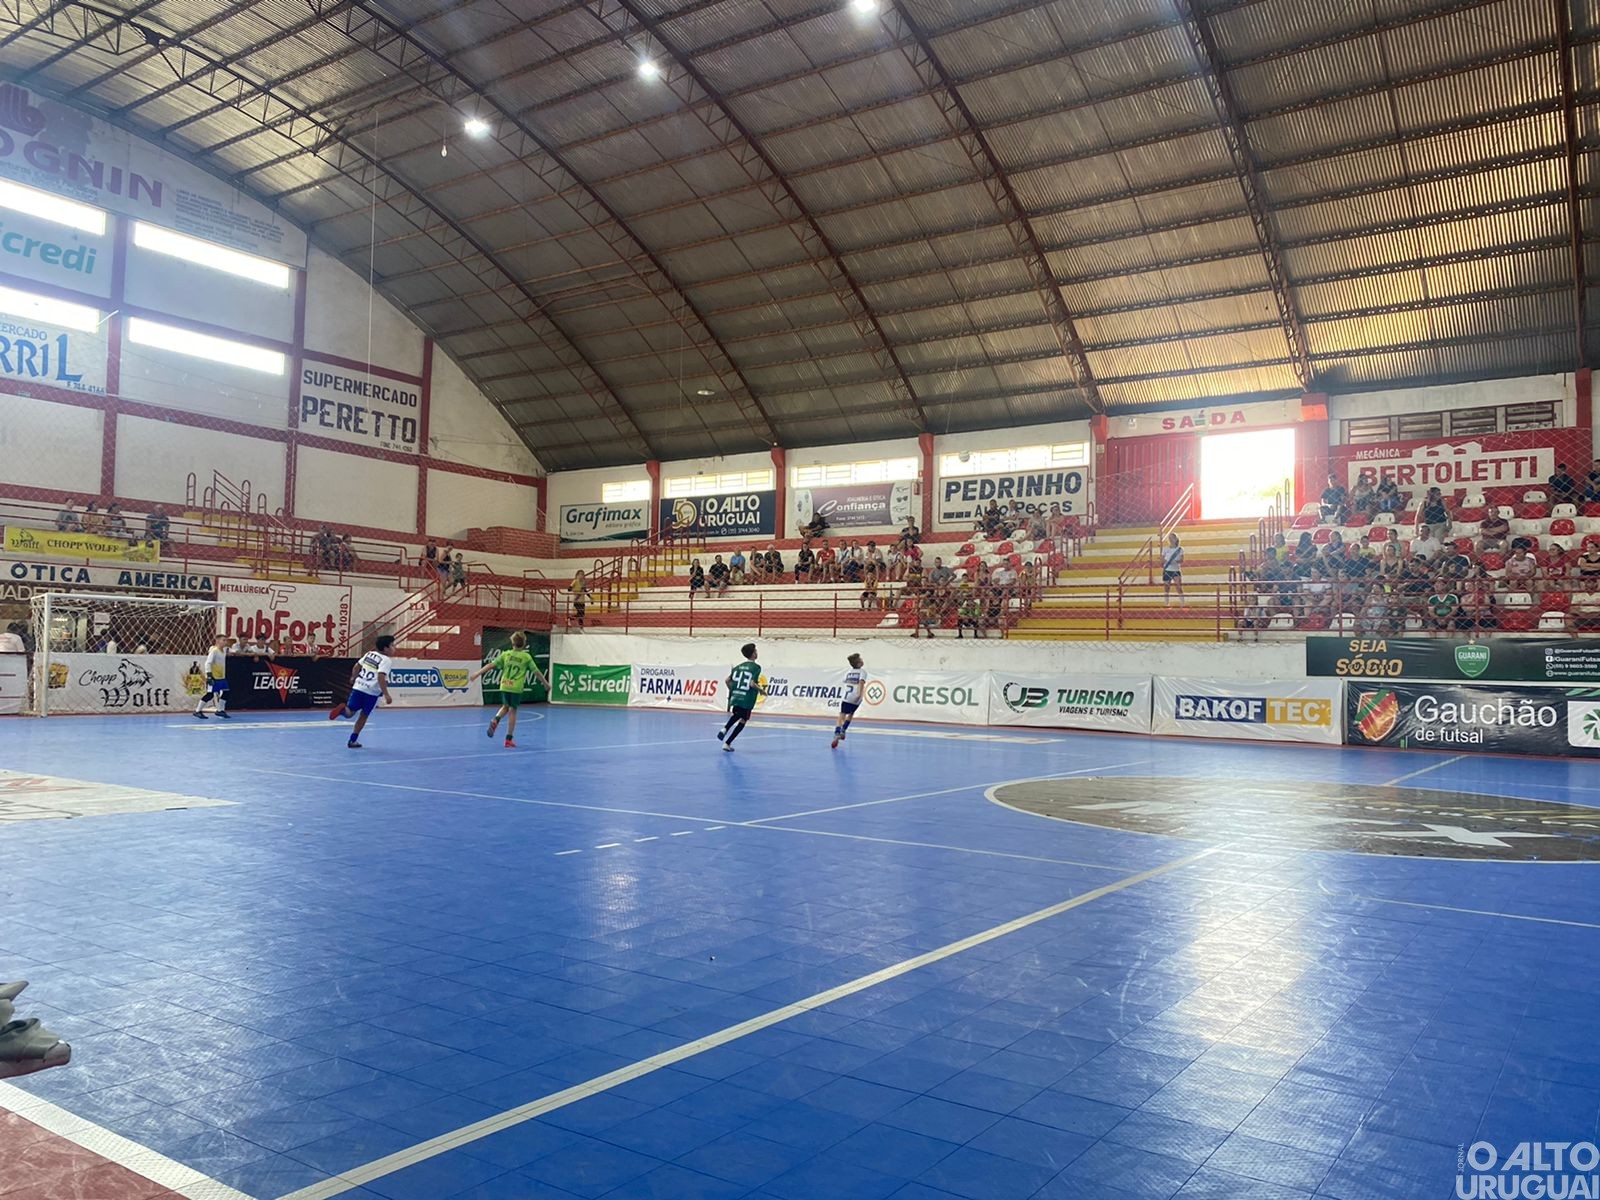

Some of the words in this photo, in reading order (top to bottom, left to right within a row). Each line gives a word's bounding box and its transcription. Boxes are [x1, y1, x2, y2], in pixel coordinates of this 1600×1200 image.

[0, 222, 97, 274] credi
[0, 322, 47, 342] ERCADO
[303, 369, 417, 408] SUPERMERCADO
[301, 395, 417, 444] PERETTO
[1355, 447, 1400, 460] MECÂNICA
[1360, 455, 1538, 487] BERTOLETTI
[945, 471, 1082, 502] PEDRINHO
[705, 498, 718, 513] O
[719, 494, 760, 513] ALTO
[817, 499, 886, 517] Confiança
[974, 504, 1009, 518] Ao
[566, 507, 642, 530] Grafimax
[699, 511, 760, 527] URUGUAI
[47, 539, 83, 550] CHOPP
[84, 543, 119, 553] WOLFF
[220, 583, 270, 595] METALÚRGICA
[339, 603, 349, 626] 1038
[225, 607, 336, 644] TubFort
[1349, 640, 1387, 652] SEJA
[1335, 654, 1403, 676] SÓCIO
[1458, 652, 1487, 660] GUARANI
[79, 669, 118, 687] Chopp
[641, 668, 675, 677] DROGARIA
[732, 671, 753, 691] 43
[769, 677, 788, 685] Posto
[253, 676, 300, 690] LEAGUE
[578, 674, 630, 693] Sicredi
[792, 685, 842, 699] CENTRAL
[100, 687, 170, 708] Wolff
[893, 685, 979, 706] CRESOL
[1057, 689, 1135, 707] TURISMO
[1059, 706, 1088, 715] VIAGENS
[1089, 707, 1094, 715] E
[1095, 707, 1129, 717] TURISMO
[1179, 698, 1262, 720] BAKOF
[1269, 701, 1320, 722] TEC
[1414, 695, 1557, 727] Gauchão
[1415, 727, 1435, 741] de
[1440, 727, 1484, 743] futsal
